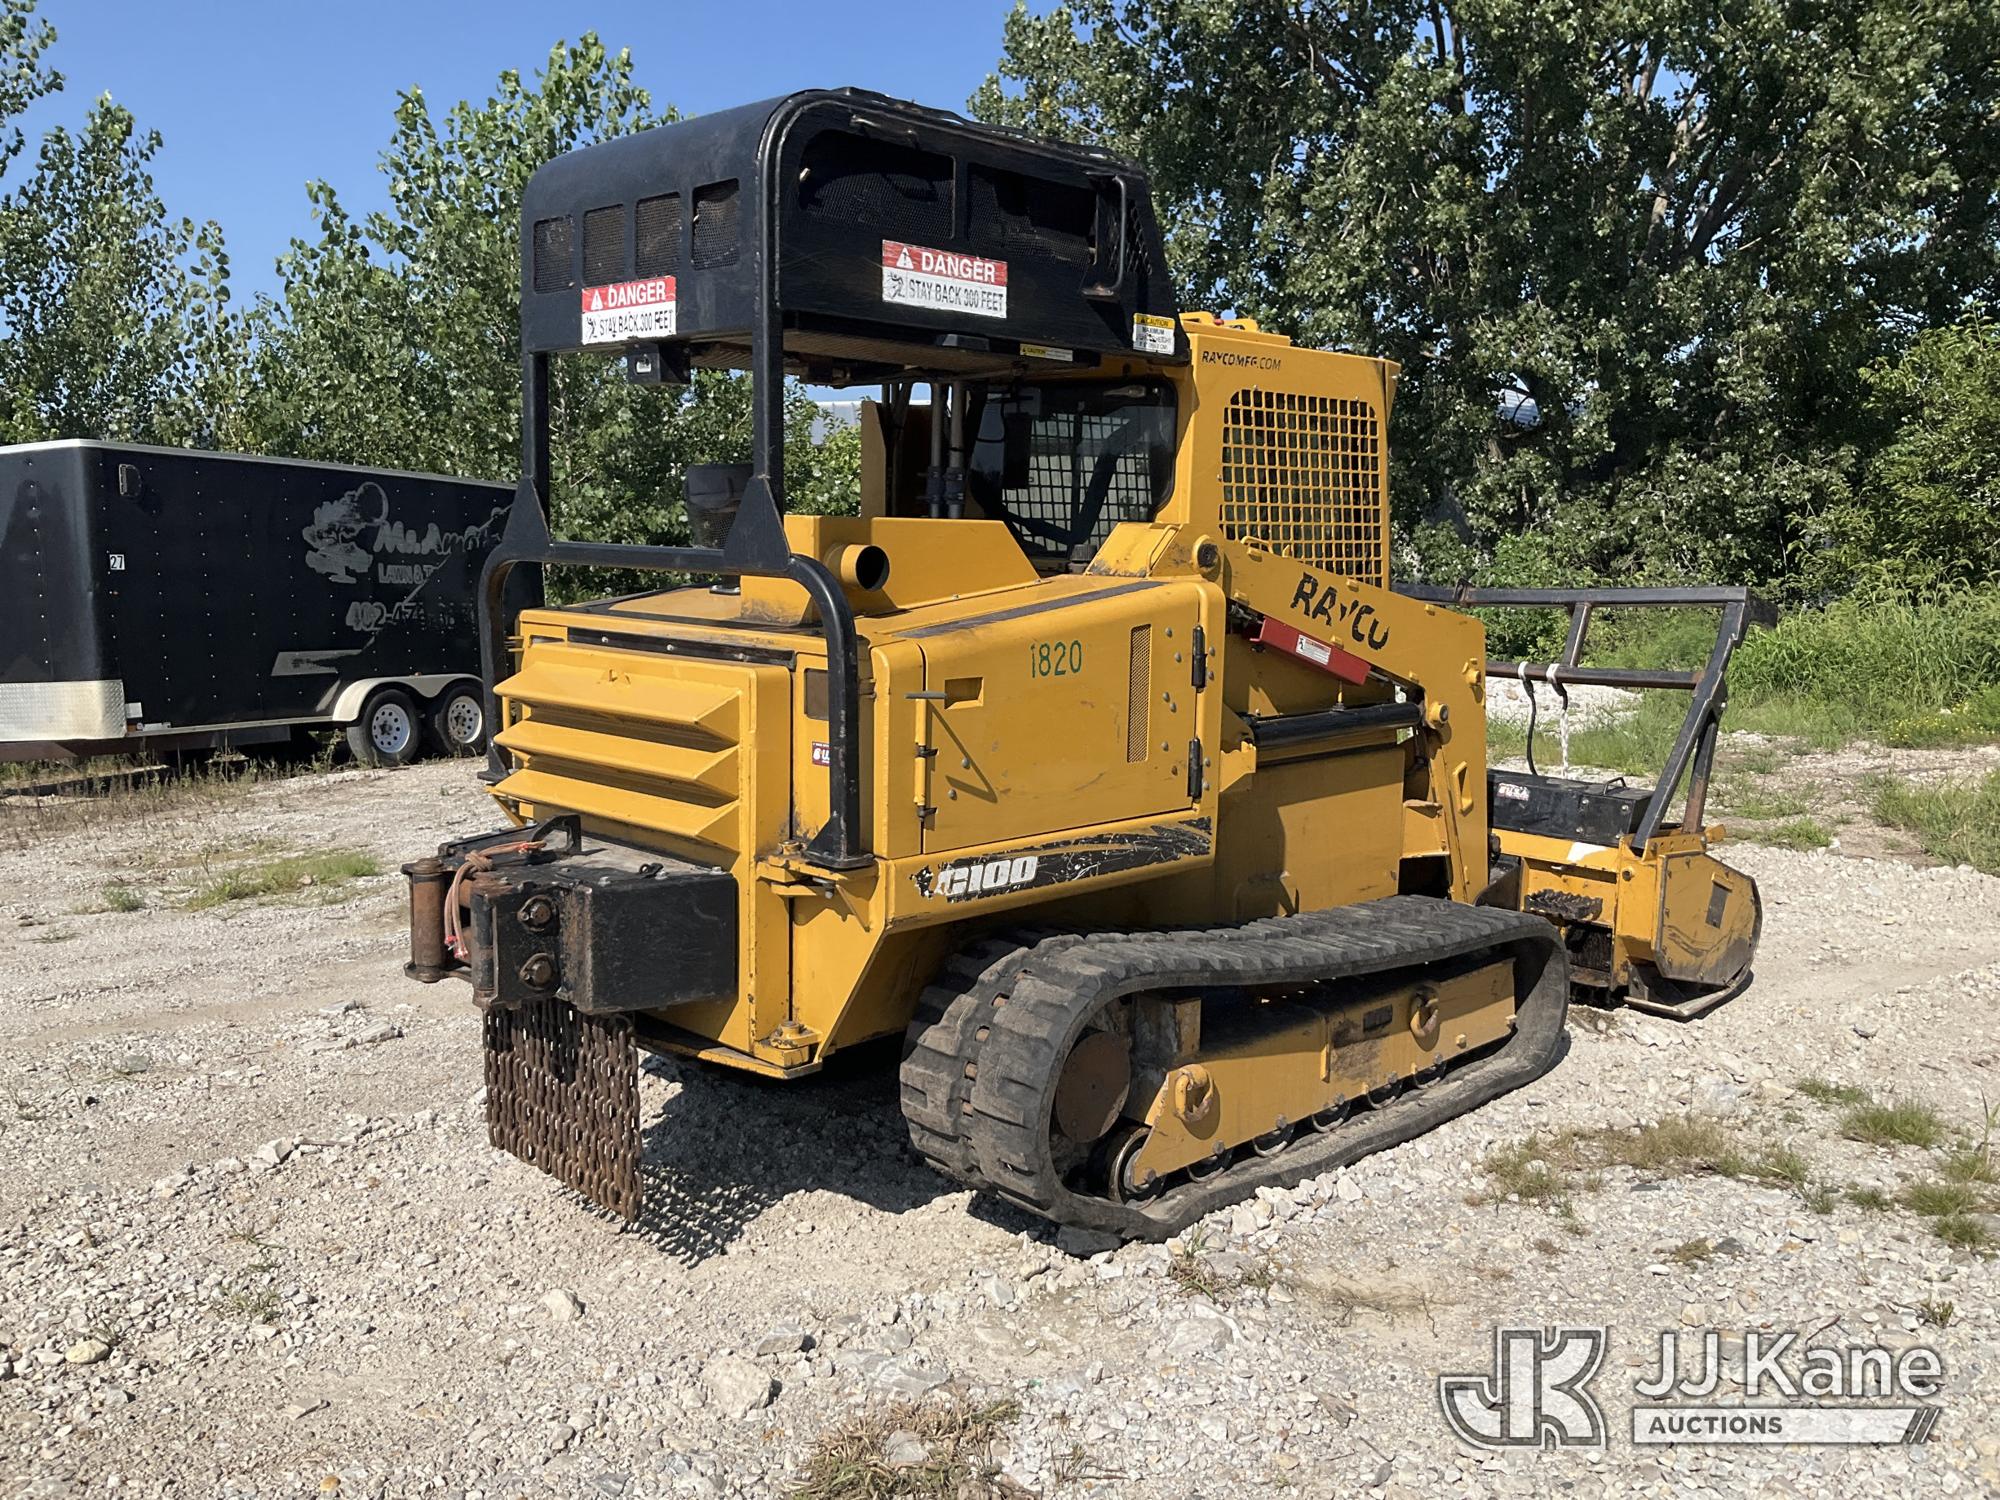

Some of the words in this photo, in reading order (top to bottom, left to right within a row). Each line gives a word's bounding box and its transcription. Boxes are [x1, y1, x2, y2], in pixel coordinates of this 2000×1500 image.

[921, 251, 995, 282] DANGER
[608, 281, 666, 307] DANGER
[909, 279, 932, 299] STAY
[935, 284, 961, 305] BACK
[964, 288, 978, 308] 300
[981, 290, 1003, 311] FEET
[600, 316, 617, 336] STAY
[618, 314, 639, 333] BACK
[640, 312, 652, 331] 300
[654, 309, 673, 330] FEET
[1145, 317, 1169, 327] CAUTION
[1202, 351, 1281, 371] RAYCOMFG.COM
[110, 555, 123, 569] 27
[1030, 639, 1082, 678] 1820
[937, 856, 1038, 896] C100
